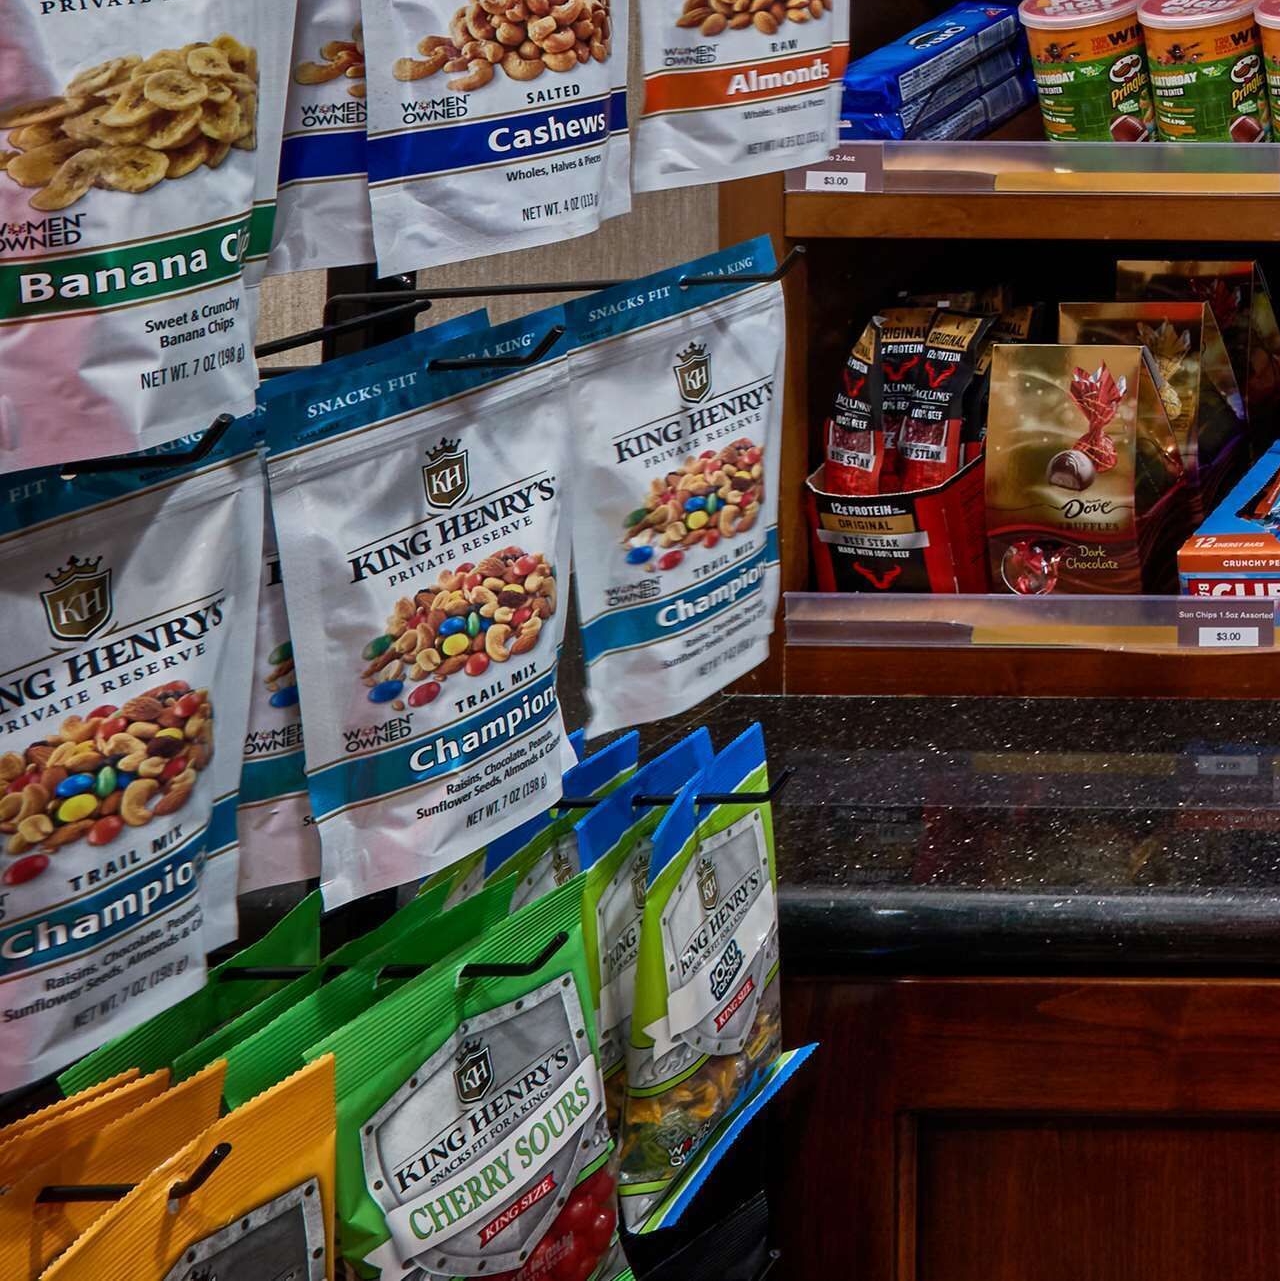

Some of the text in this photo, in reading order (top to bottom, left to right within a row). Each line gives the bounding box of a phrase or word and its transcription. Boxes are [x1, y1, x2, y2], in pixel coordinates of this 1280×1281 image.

[769, 38, 799, 53] RAW
[526, 83, 581, 104] SALTED
[726, 60, 830, 96] Almonds
[487, 111, 606, 151] Cashews
[19, 248, 208, 304] Banana
[144, 296, 240, 334] Sweet & Crunchy
[160, 316, 235, 349] Banana Chips
[1061, 499, 1114, 518] Dove
[348, 476, 556, 584] KING HENRY'S
[1066, 557, 1119, 570] Chocolate
[1078, 545, 1106, 557] Dark
[1222, 558, 1264, 567] CRUNCHY
[455, 662, 537, 713] TRAIL MIX
[393, 1046, 571, 1194] KING HENRY'S
[408, 1076, 593, 1242] CHERRY SOURS
